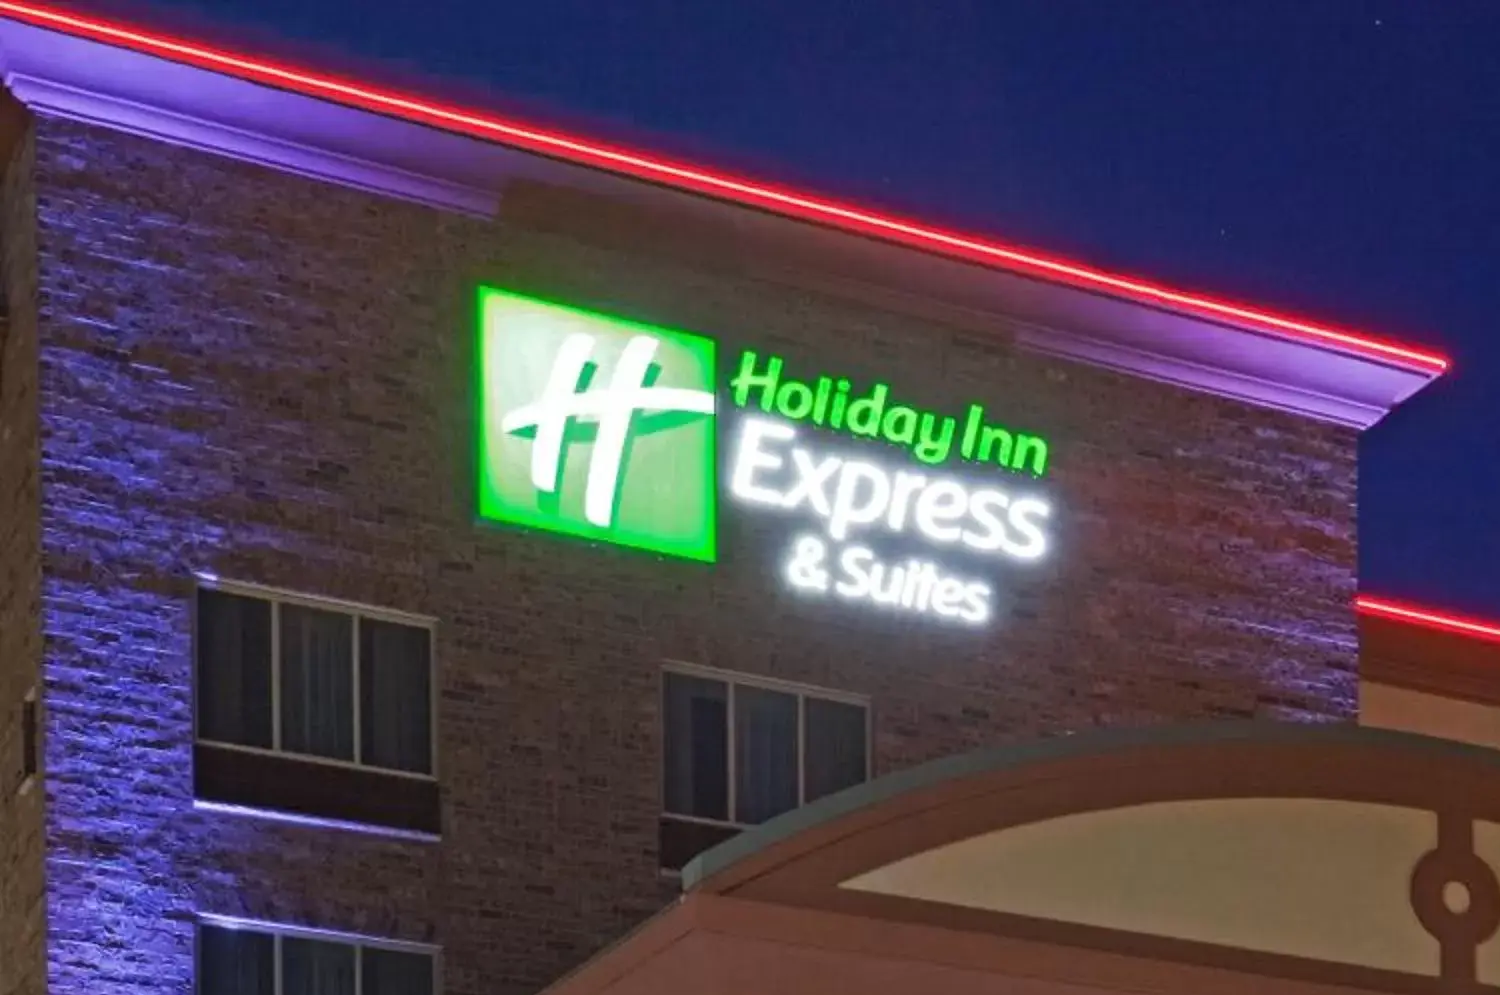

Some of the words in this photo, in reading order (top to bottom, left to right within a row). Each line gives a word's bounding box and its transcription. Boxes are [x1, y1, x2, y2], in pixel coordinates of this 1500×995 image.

[730, 351, 955, 464] Holiday
[961, 405, 1049, 476] Inn
[731, 419, 1051, 560] Express
[788, 537, 828, 591] &
[836, 547, 992, 623] Suites
